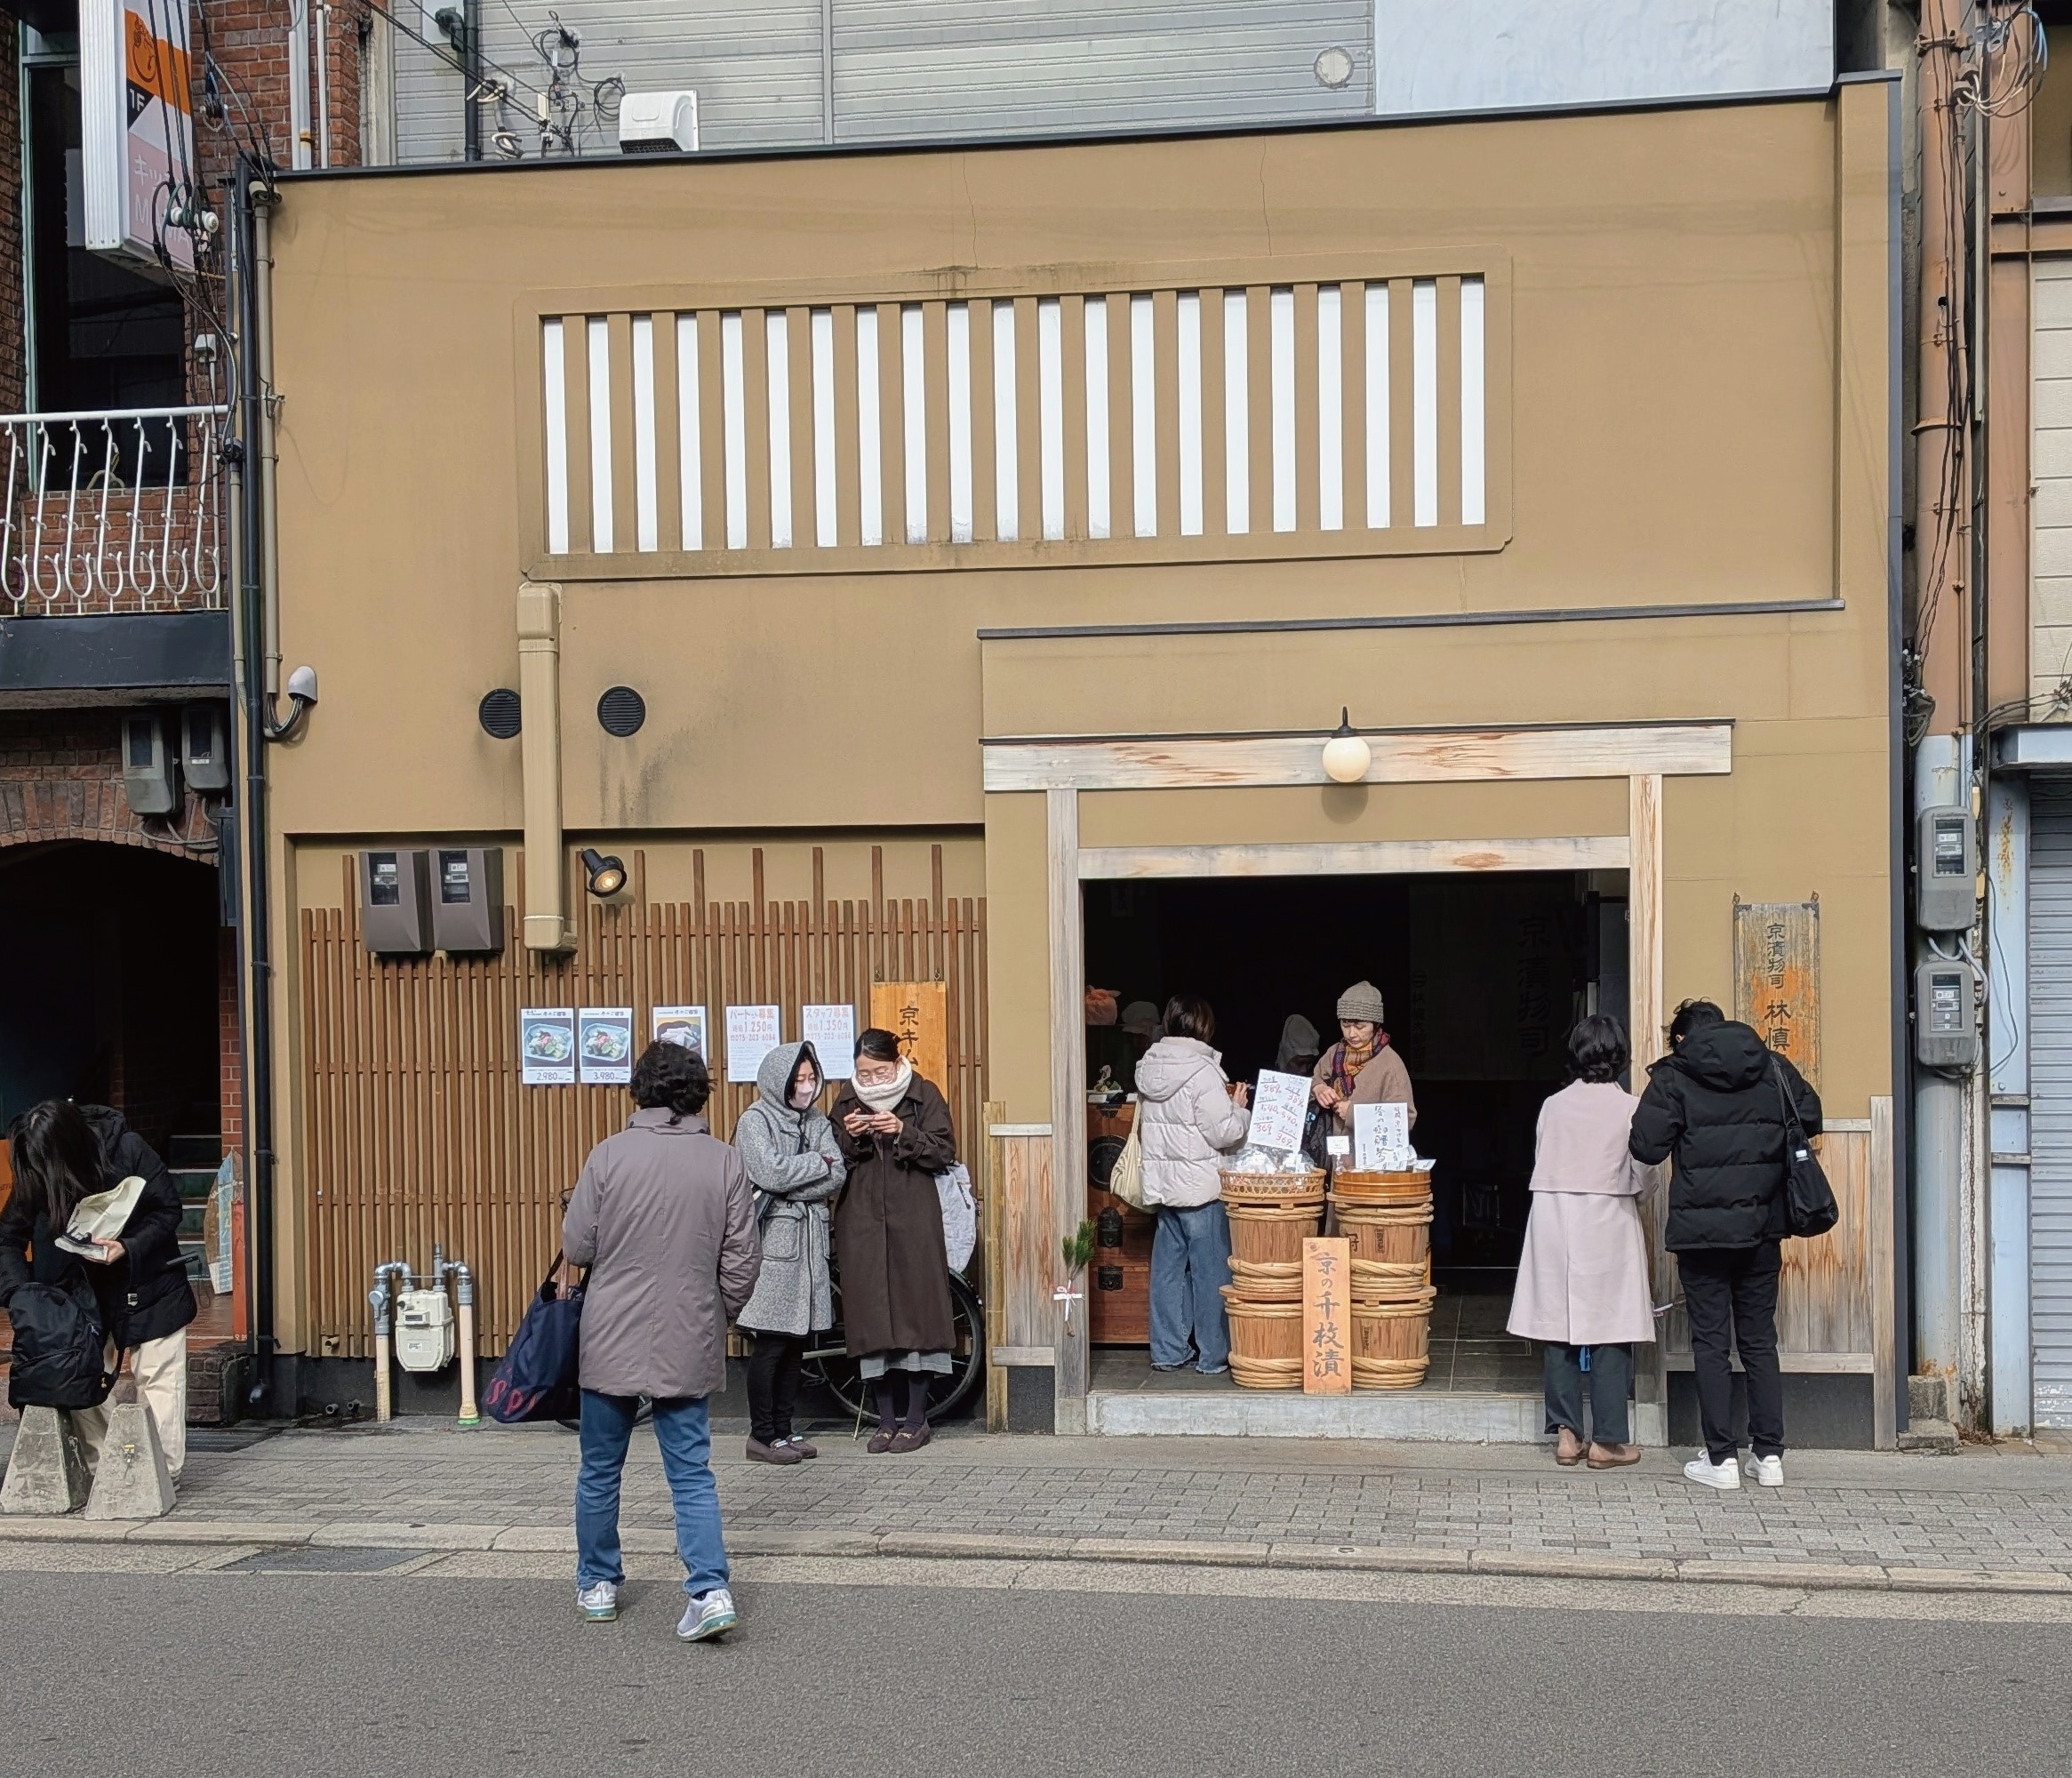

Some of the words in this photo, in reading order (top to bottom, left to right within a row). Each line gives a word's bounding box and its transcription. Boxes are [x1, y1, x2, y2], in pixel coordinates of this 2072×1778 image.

[129, 88, 145, 112] 1F
[1767, 922, 1785, 989] 京漬物司
[1313, 1252, 1345, 1378] 京の千枚漬
